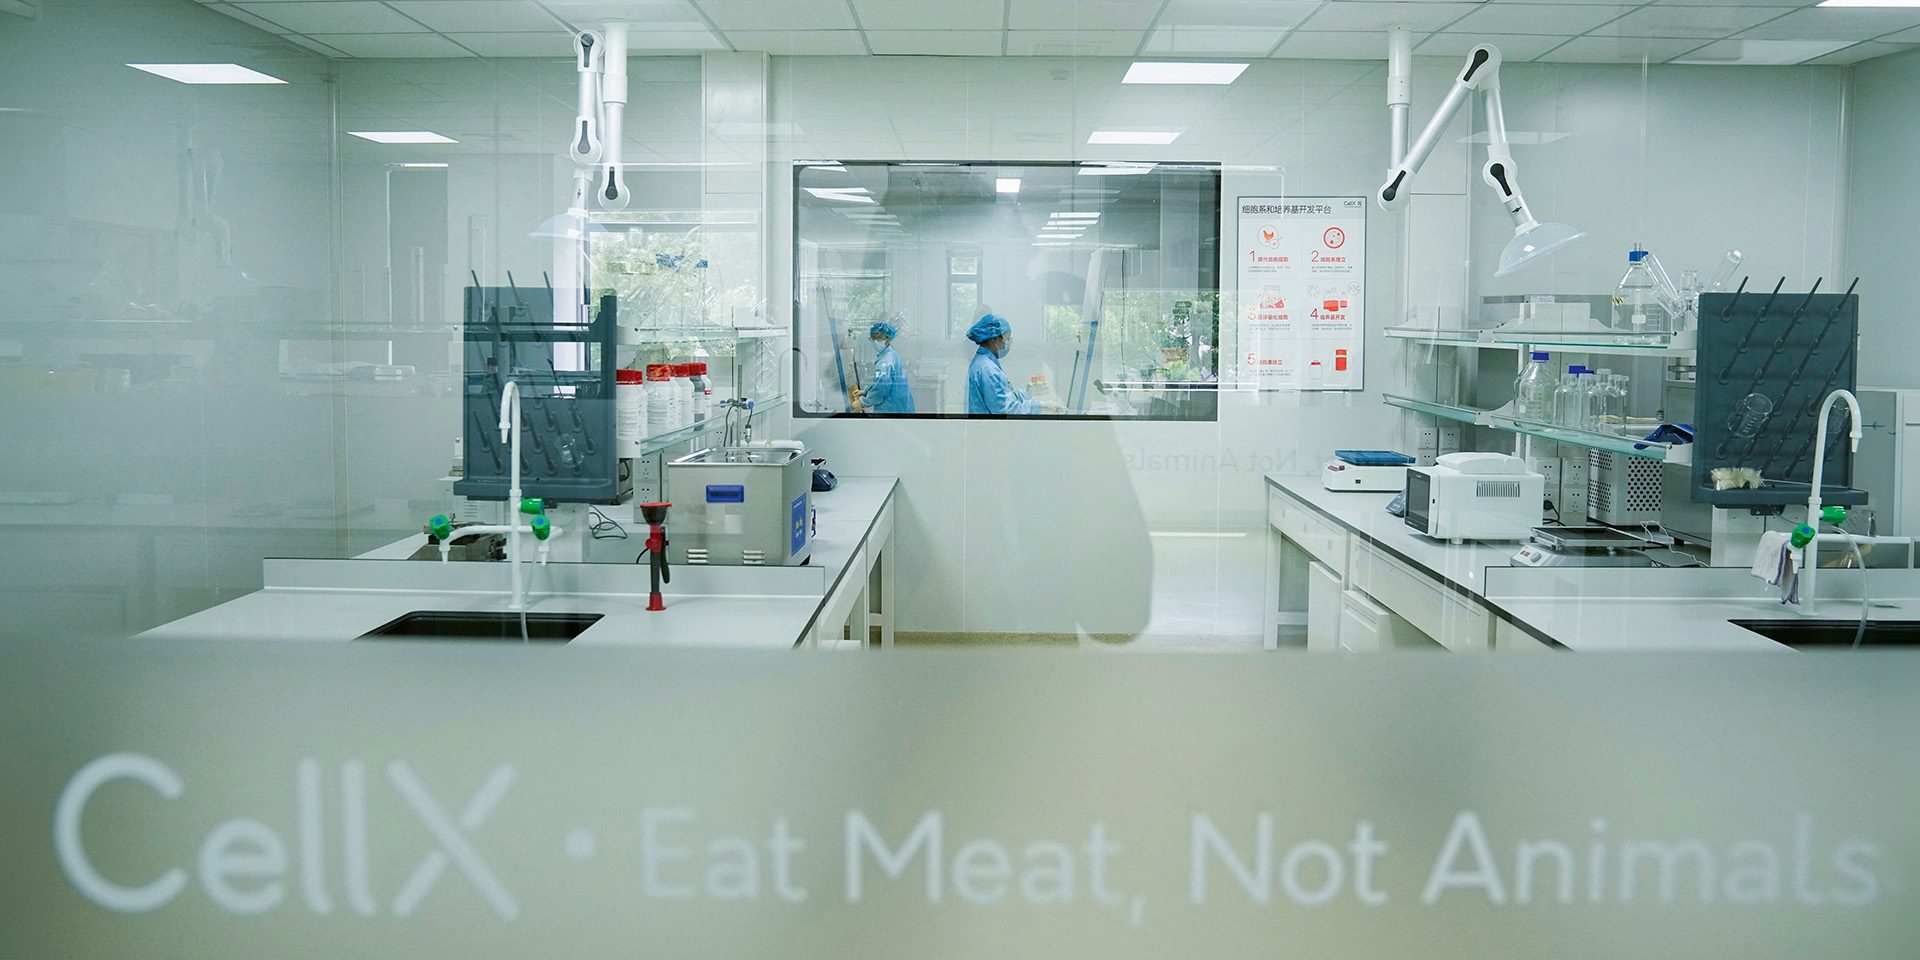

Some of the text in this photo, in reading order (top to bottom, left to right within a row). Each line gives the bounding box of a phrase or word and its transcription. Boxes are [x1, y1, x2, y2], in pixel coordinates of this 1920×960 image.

[1241, 204, 1332, 214] 细胞系和培养基开发平台
[1249, 250, 1255, 262] 1
[1311, 250, 1319, 262] 2
[1310, 308, 1319, 320] 4
[1247, 353, 1256, 365] 5
[54, 752, 521, 922] CellX
[640, 806, 807, 900] Eat
[844, 808, 1144, 927] Meat,
[1189, 809, 1390, 906] Not
[1421, 810, 1882, 907] Animals
